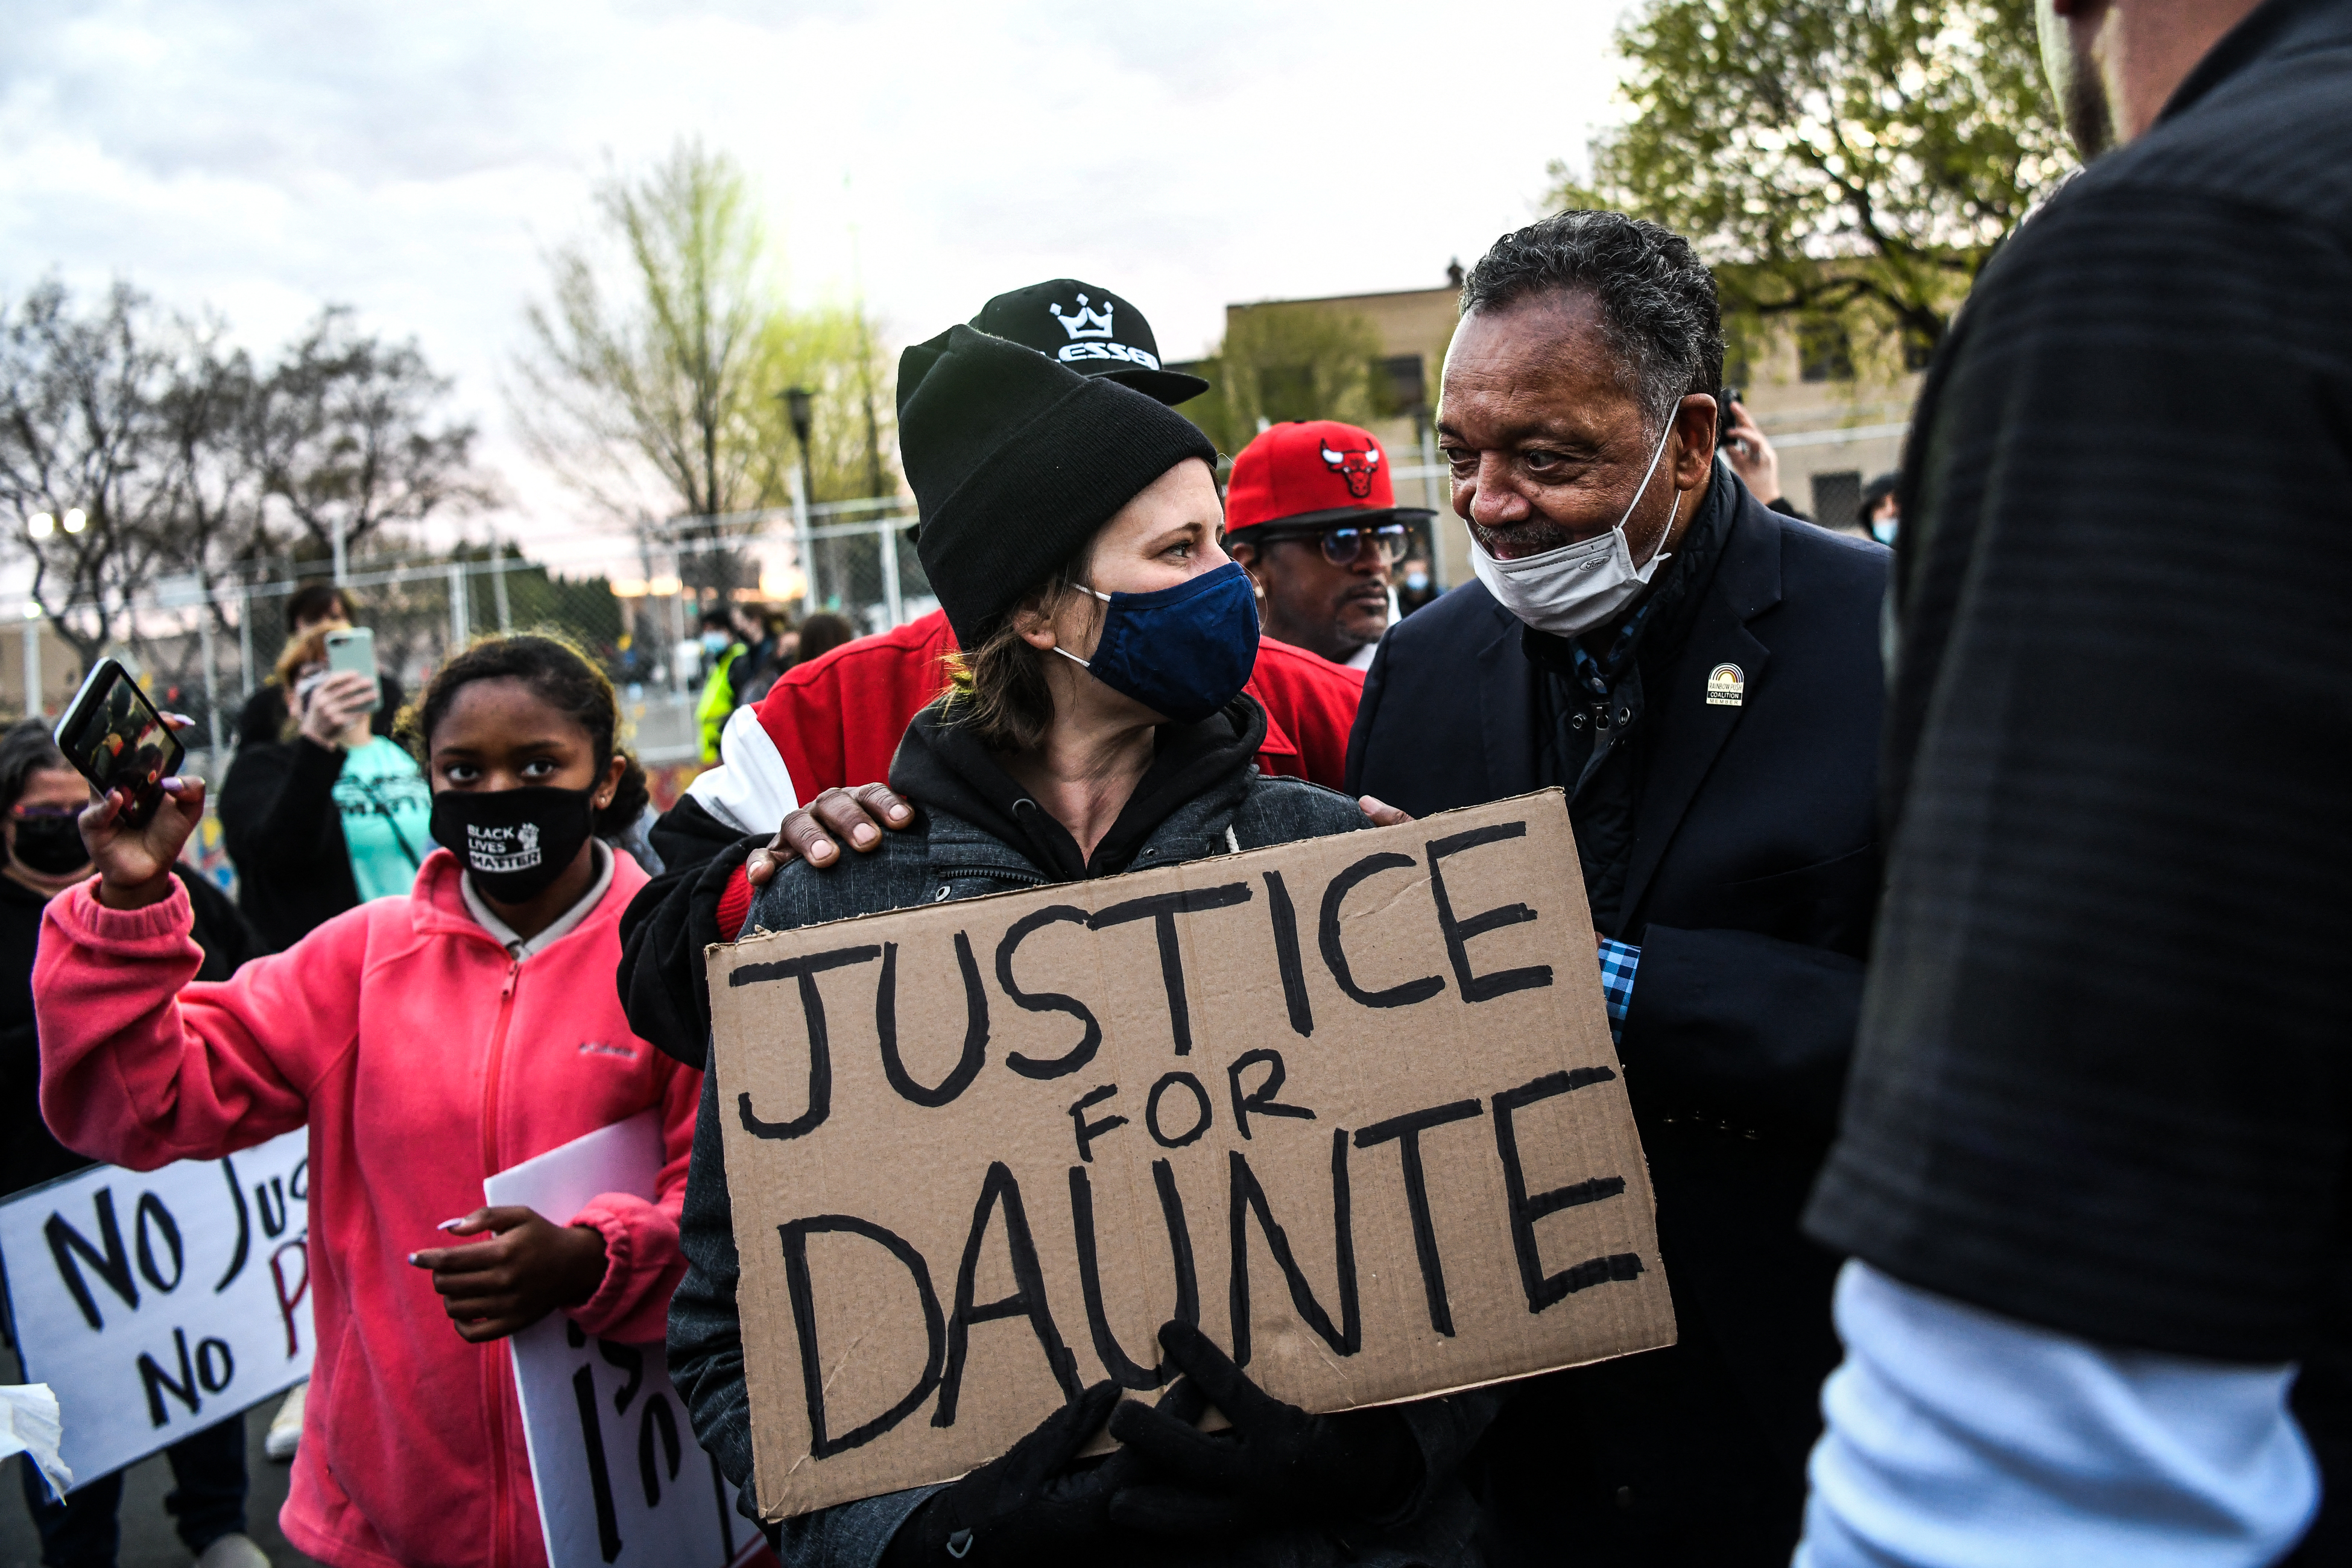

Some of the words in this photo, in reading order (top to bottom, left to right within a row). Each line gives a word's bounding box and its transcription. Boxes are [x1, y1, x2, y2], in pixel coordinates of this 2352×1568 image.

[1040, 341, 1160, 371] ESSED
[467, 824, 514, 841] BLACK
[469, 838, 507, 854] LIVES
[472, 850, 539, 870] MATTER
[729, 820, 1554, 1140] JUSTICE
[1067, 1048, 1317, 1163] FOR
[776, 1065, 1645, 1460] DAUNTE
